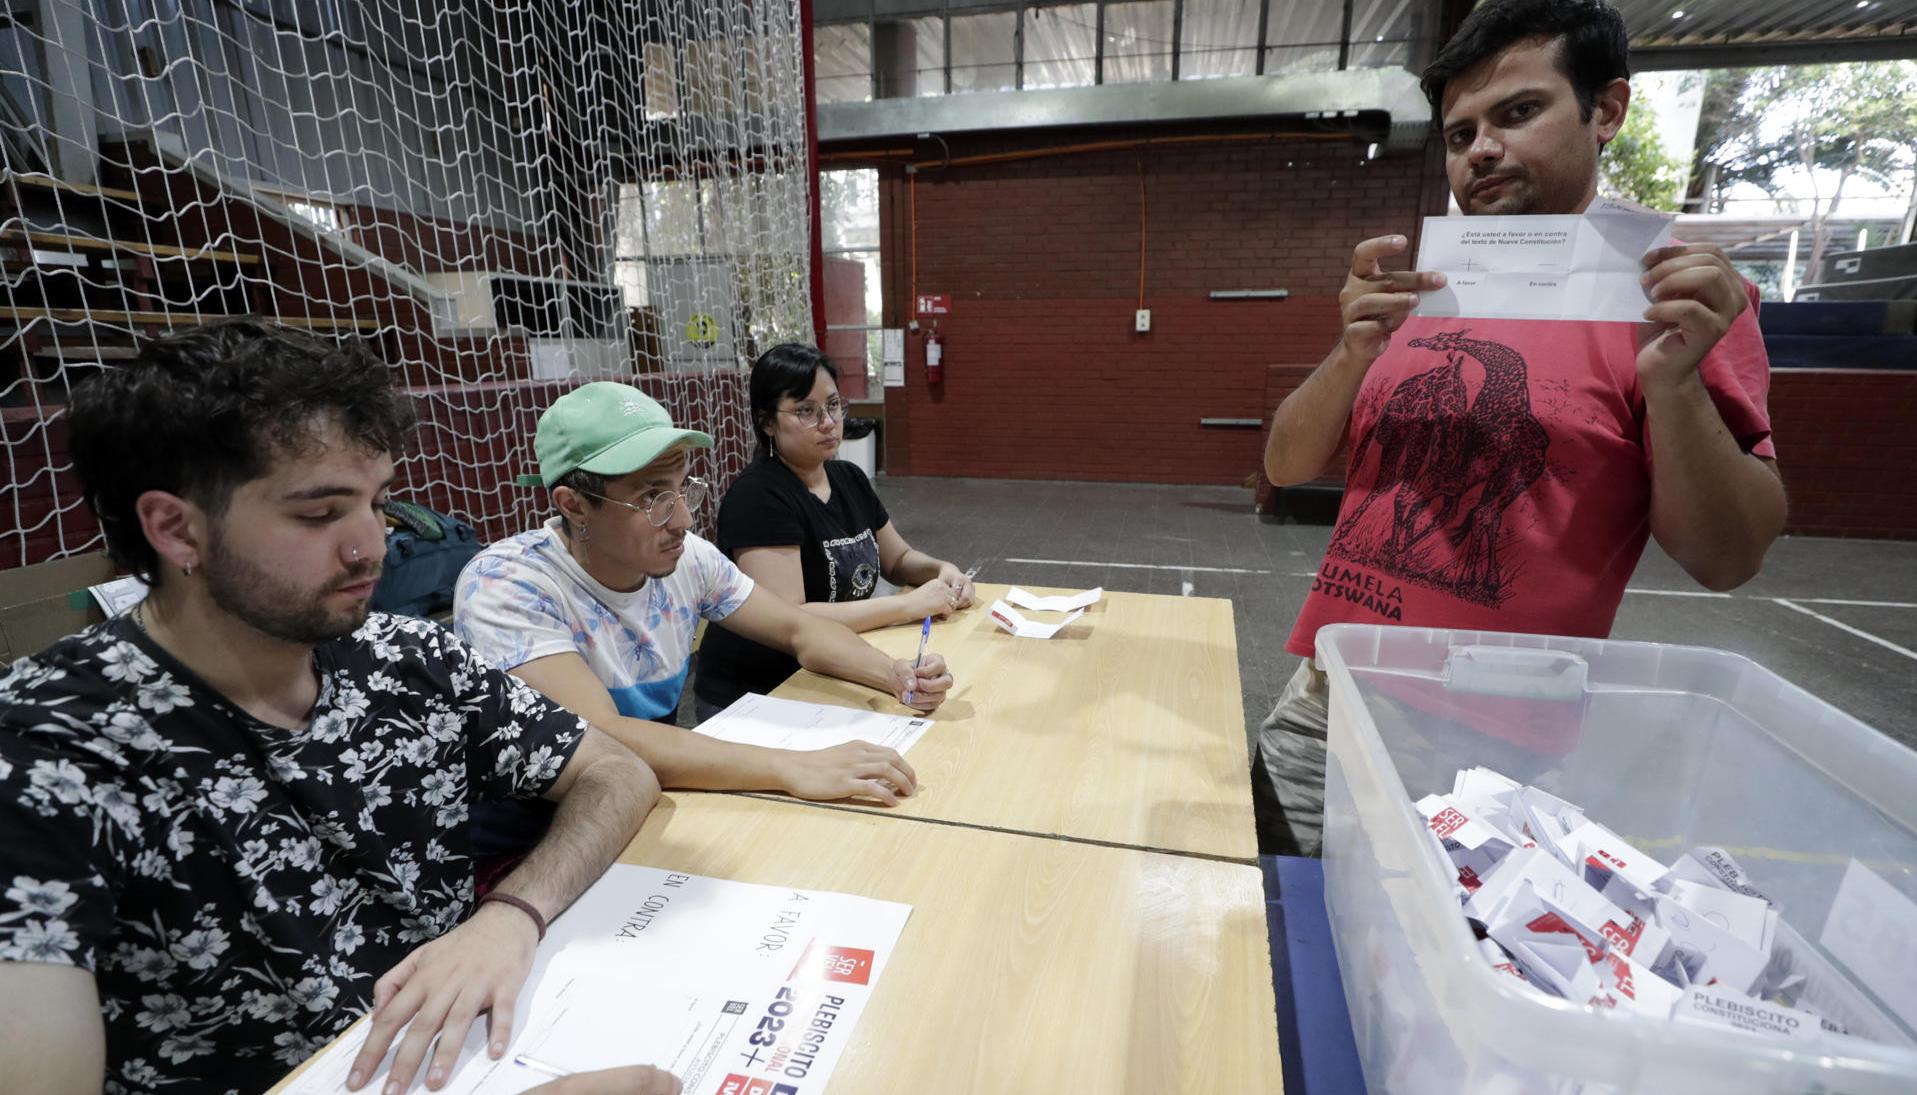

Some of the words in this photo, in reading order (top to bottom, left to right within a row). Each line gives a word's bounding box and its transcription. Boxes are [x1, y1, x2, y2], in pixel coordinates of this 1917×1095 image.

[663, 873, 690, 888] EN
[788, 892, 809, 902] A
[1693, 992, 1800, 1029] PLEBISCITO
[784, 994, 845, 1079] PLEBISCITO
